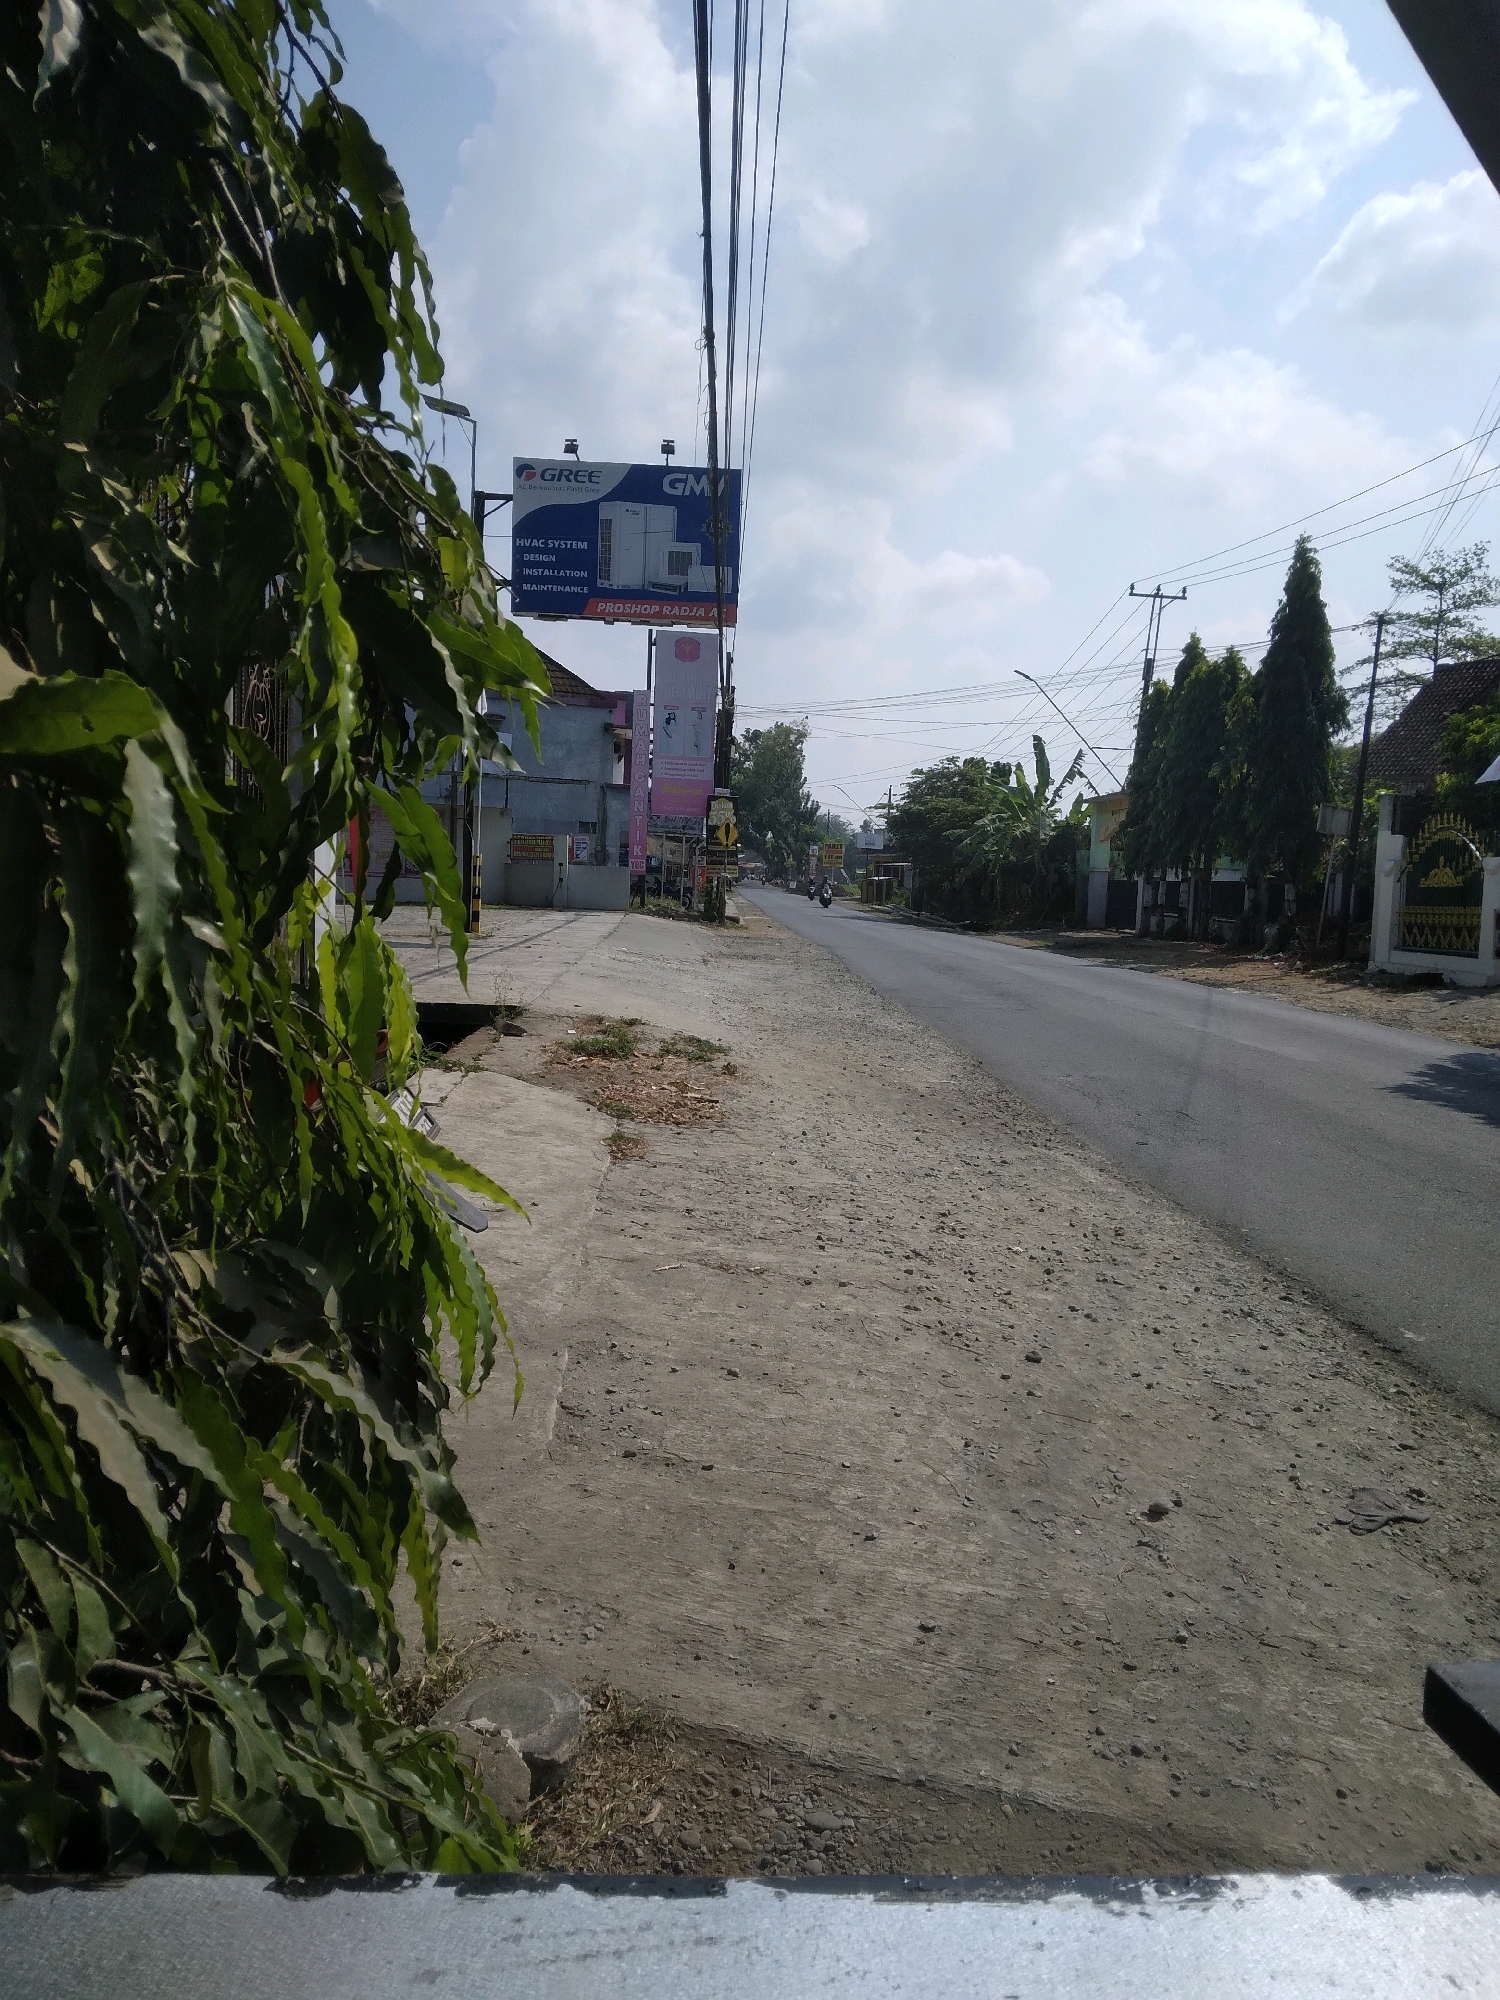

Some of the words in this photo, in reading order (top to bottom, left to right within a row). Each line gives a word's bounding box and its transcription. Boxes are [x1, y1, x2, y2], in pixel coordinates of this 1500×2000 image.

[540, 468, 602, 484] GREE
[528, 484, 565, 492] Berkuitas
[516, 538, 545, 547] HVAC
[547, 540, 588, 549] SYSTEM
[523, 553, 556, 562] DESIGN
[523, 567, 588, 578] INSTALLATION
[522, 583, 589, 594] MAINTENANCE
[597, 602, 660, 614] PROSHOP
[662, 605, 705, 617] RADJA
[634, 693, 649, 766] RUMAH
[633, 771, 646, 856] CANTIK
